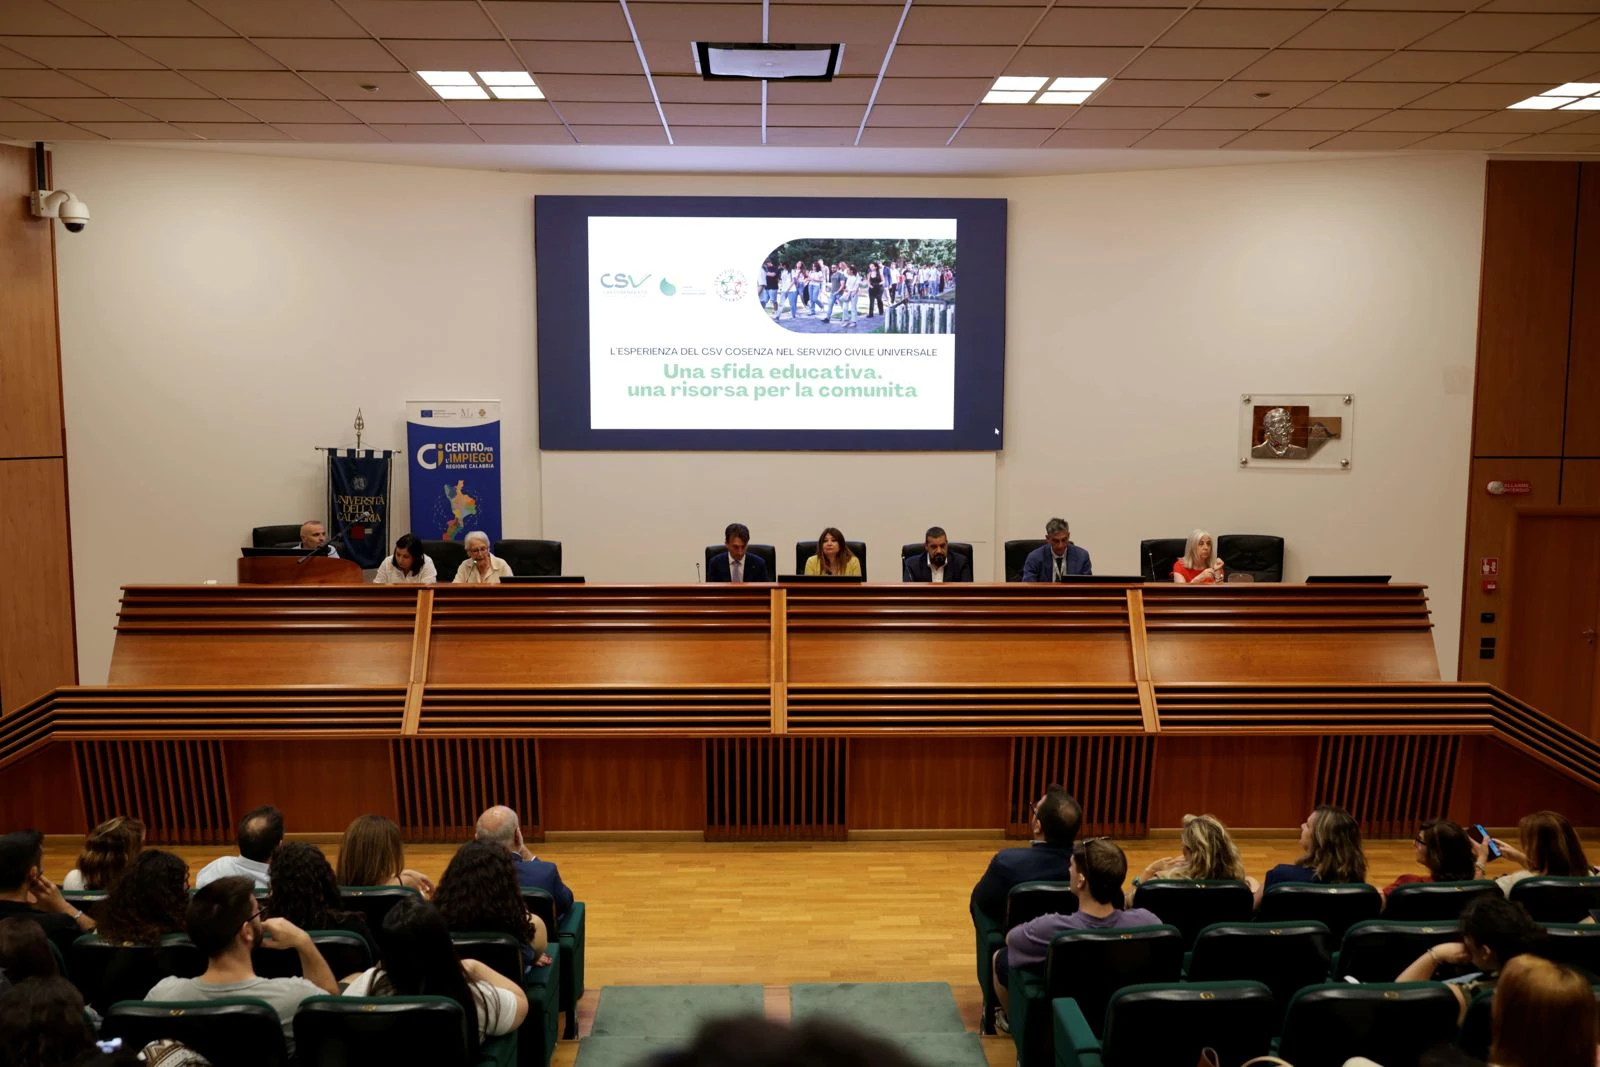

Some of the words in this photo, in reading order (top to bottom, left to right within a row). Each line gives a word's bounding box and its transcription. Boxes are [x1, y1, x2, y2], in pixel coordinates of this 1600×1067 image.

[600, 273, 652, 288] CSV
[610, 347, 678, 356] L'ESPERIENZA
[680, 347, 699, 356] DEL
[701, 347, 723, 356] CSV
[725, 347, 773, 356] COSENZA
[776, 348, 794, 356] NEL
[796, 348, 842, 356] SERVIZIO
[844, 348, 875, 356] CIVILE
[877, 348, 938, 356] UNIVERSALE
[663, 363, 705, 379] Una
[710, 363, 765, 379] sfida
[769, 363, 883, 379] educativa.
[627, 385, 666, 397] una
[671, 381, 749, 397] risorsa
[754, 385, 791, 401] per
[795, 382, 813, 397] la
[818, 381, 918, 398] comunita
[445, 442, 484, 452] CENTRO
[342, 504, 374, 513] DELLA
